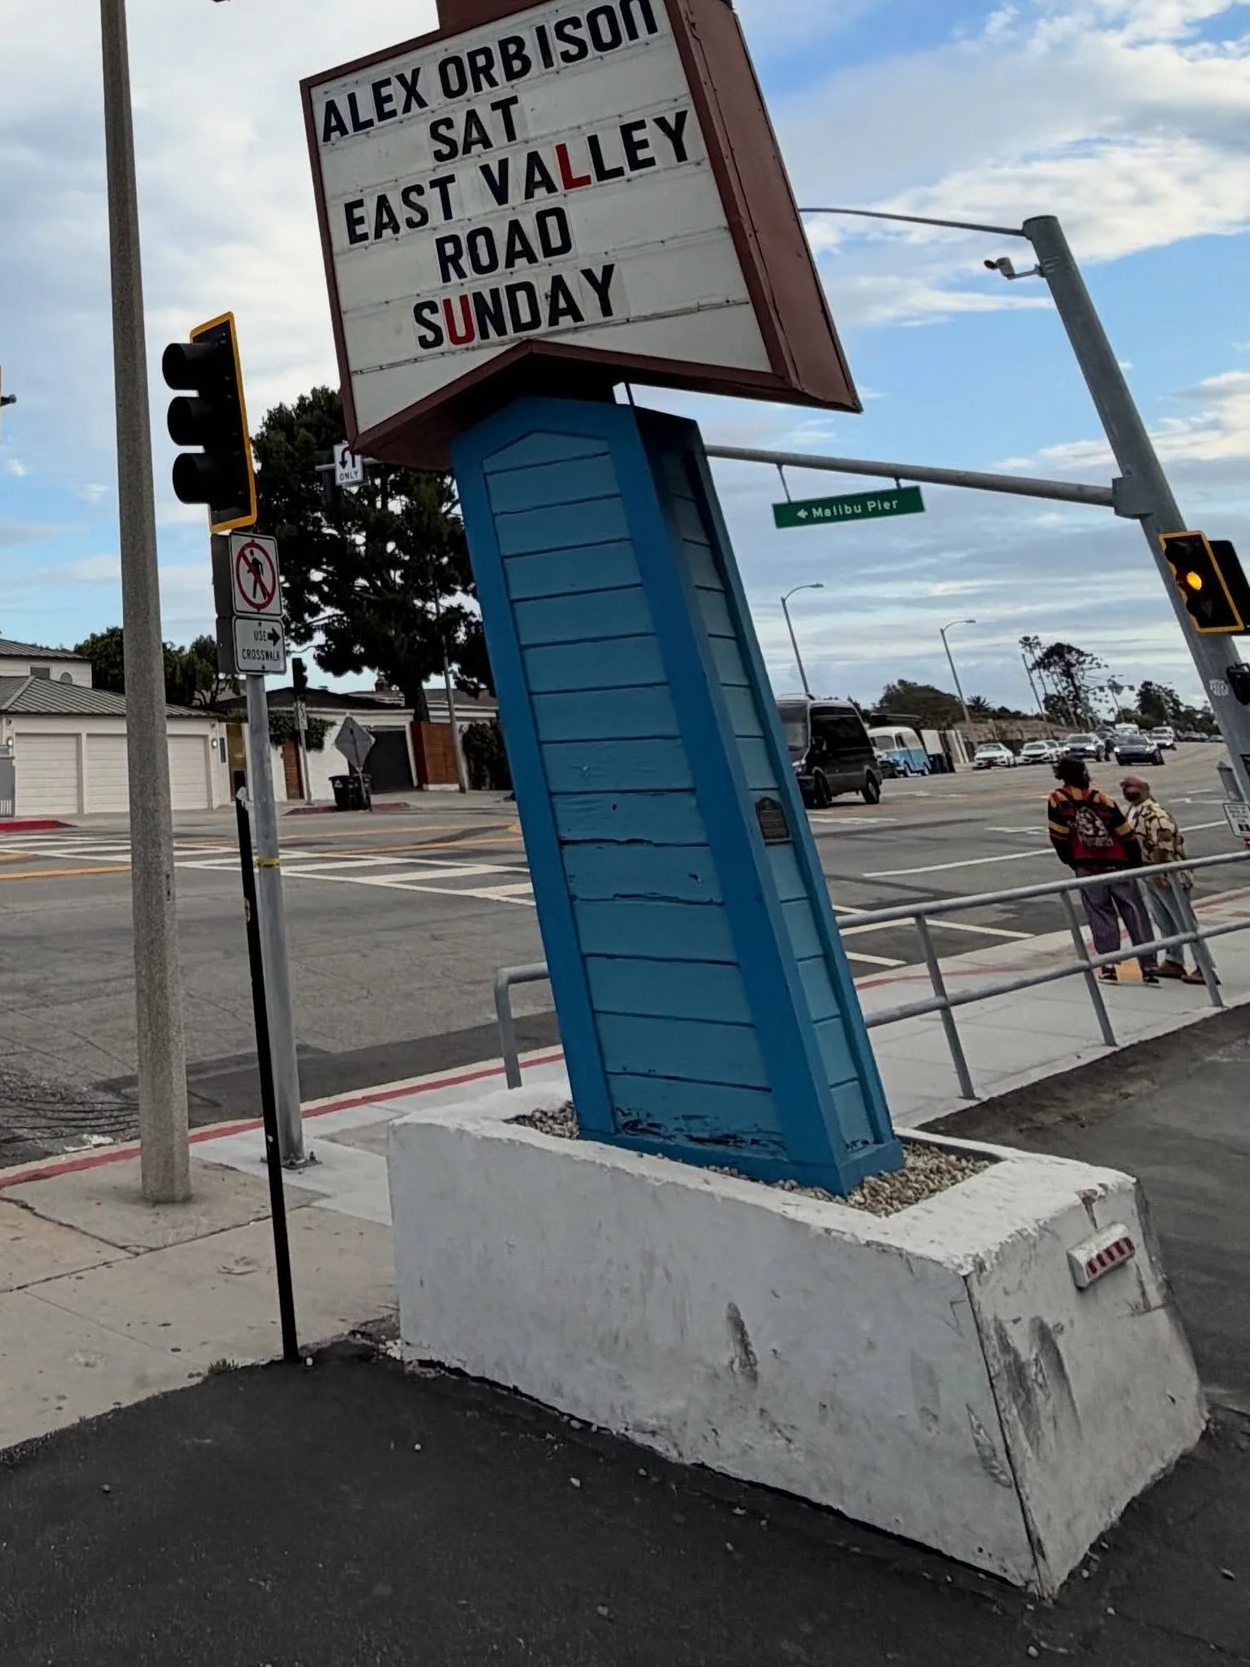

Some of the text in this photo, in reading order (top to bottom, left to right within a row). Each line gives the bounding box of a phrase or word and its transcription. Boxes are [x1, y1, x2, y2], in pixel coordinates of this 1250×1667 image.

[322, 67, 429, 143] ALEX
[429, 95, 520, 163] SAT
[344, 110, 689, 245] EAST VALLEY
[435, 207, 572, 283] ROAD
[413, 263, 615, 350] SUNDAY
[339, 470, 358, 481] ONLY
[812, 500, 898, 518] Malibu Pier
[241, 648, 280, 661] CROSSWALK
[253, 630, 267, 642] USE
